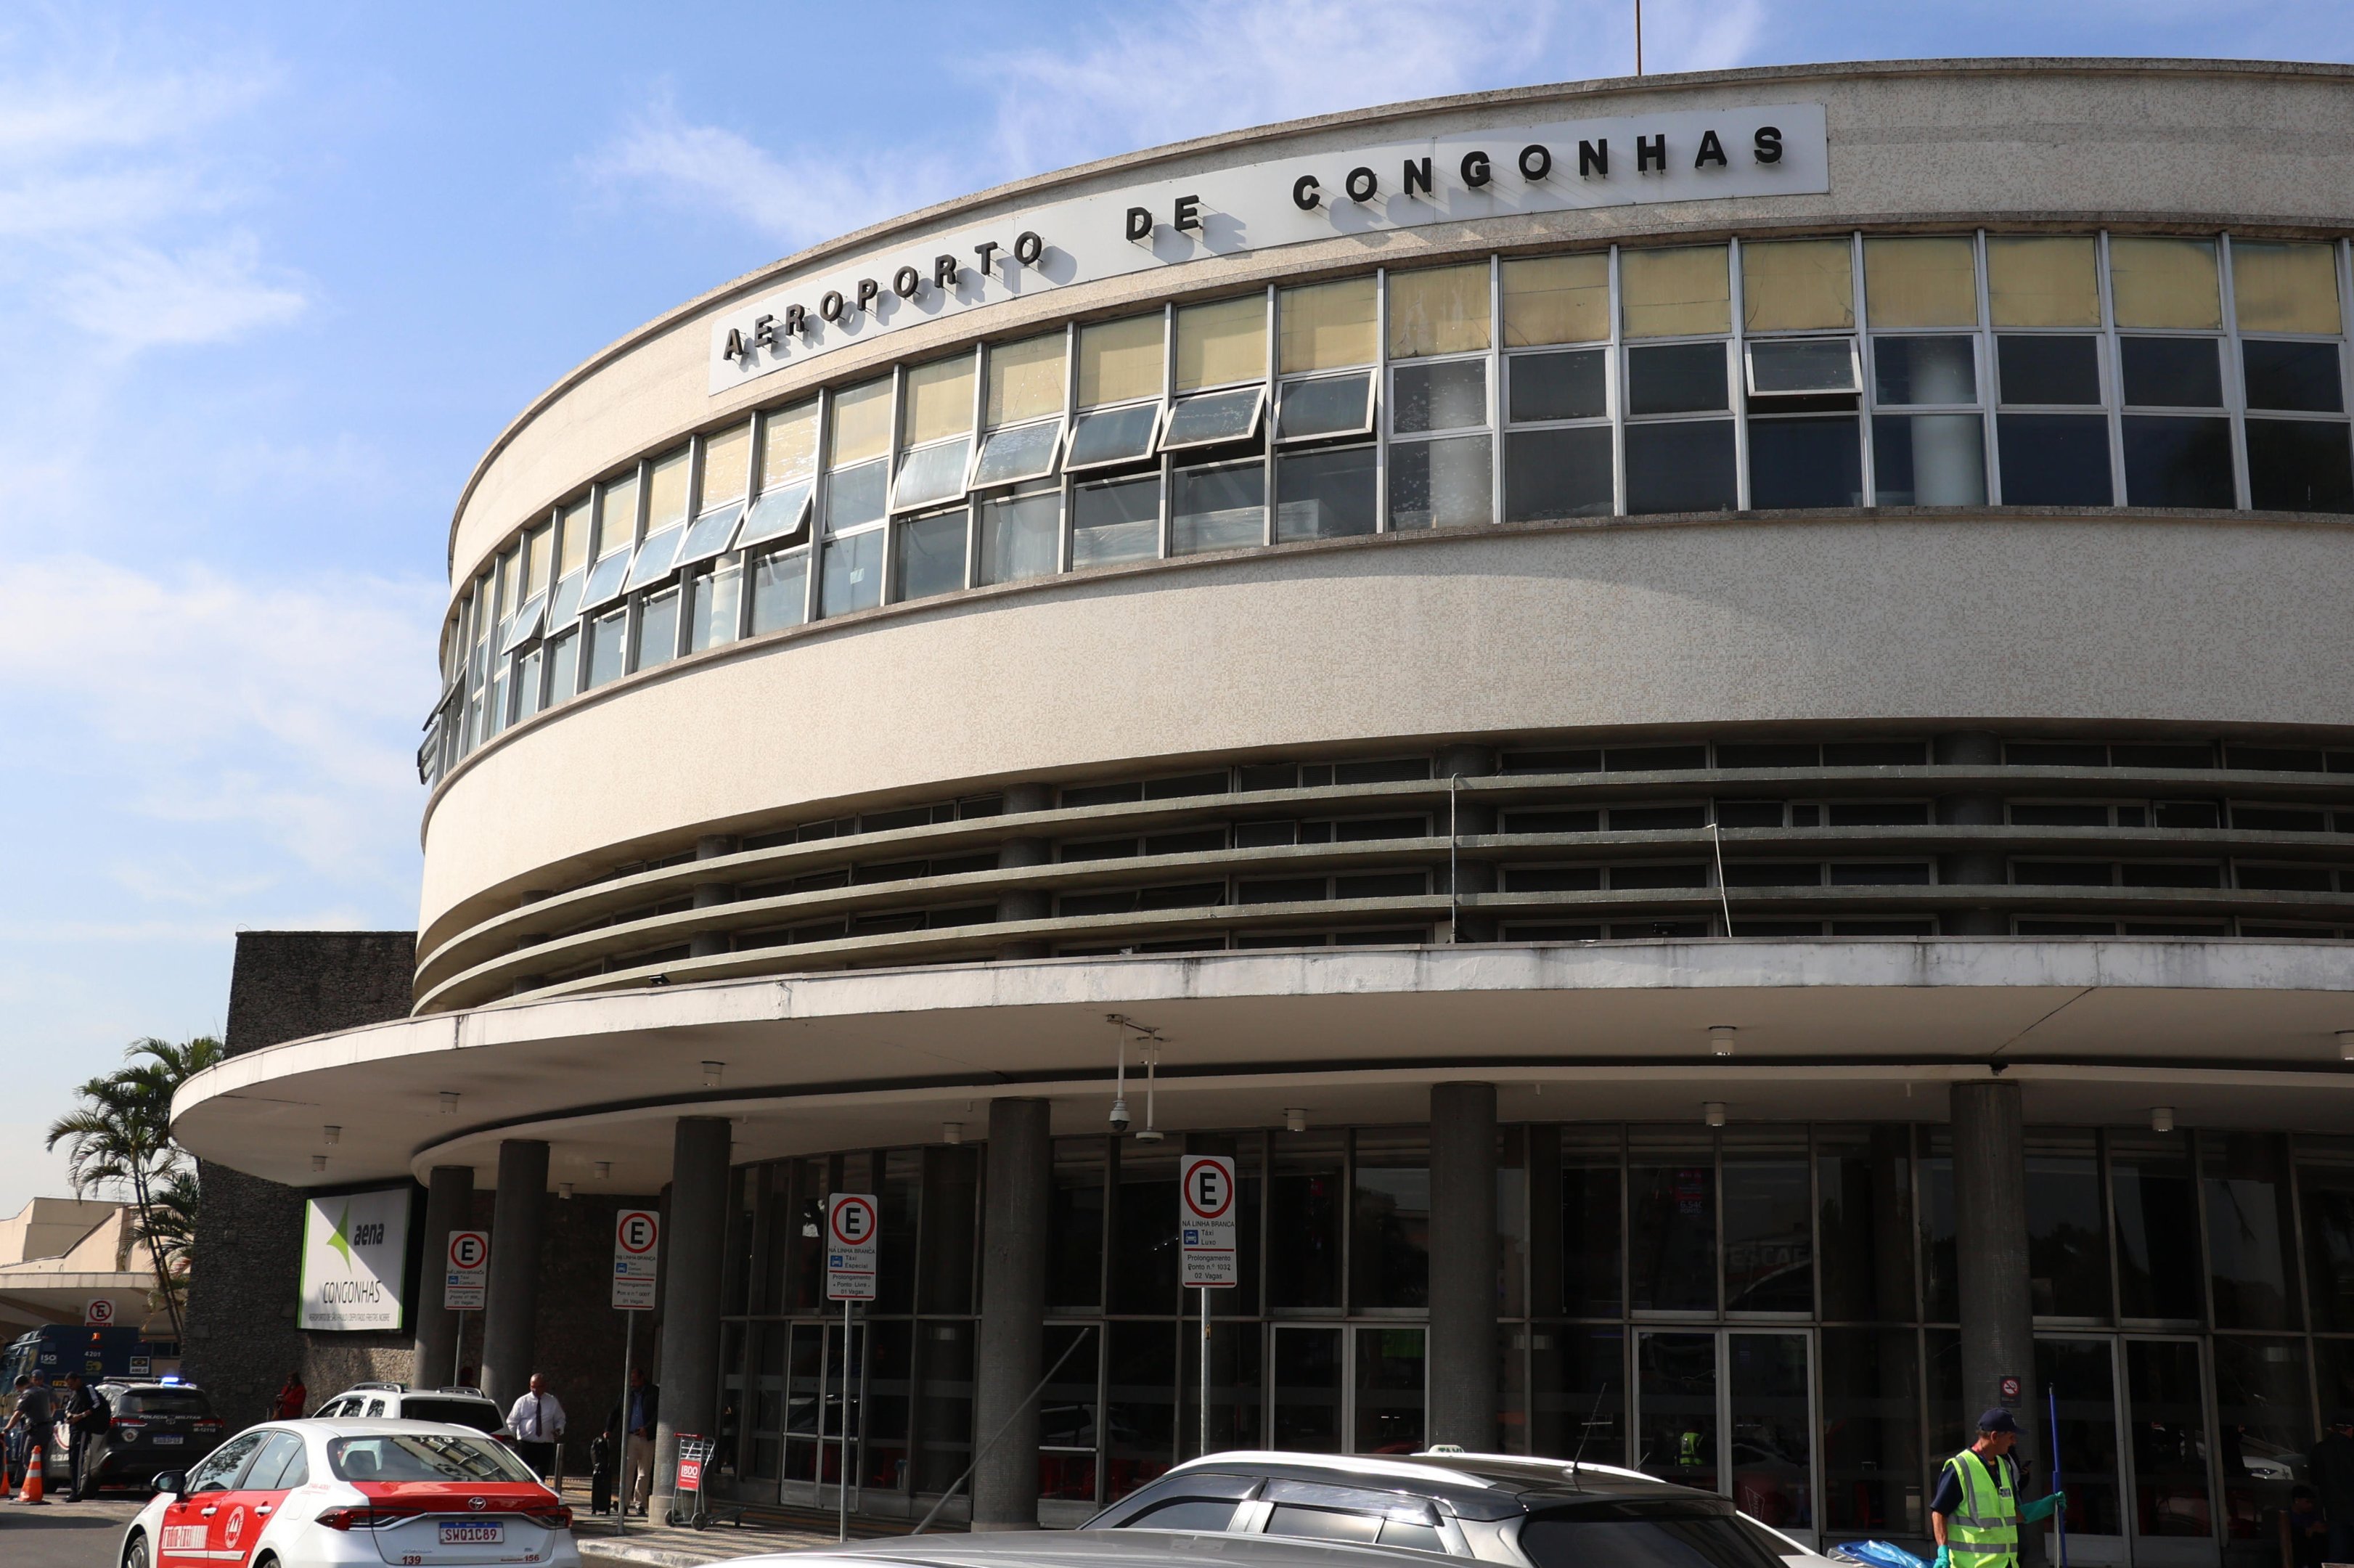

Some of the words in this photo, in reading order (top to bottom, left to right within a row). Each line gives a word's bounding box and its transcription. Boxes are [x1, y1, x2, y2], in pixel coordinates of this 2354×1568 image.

[724, 231, 1042, 361] AEROPORTO
[1126, 195, 1202, 242] DE
[1292, 126, 1783, 211] CONGONHAS
[1199, 1172, 1217, 1205] E
[846, 1207, 861, 1234] E
[353, 1223, 385, 1246] aena
[630, 1222, 645, 1244] E
[461, 1241, 475, 1261] E
[1187, 1254, 1231, 1263] Prolongamento
[322, 1279, 381, 1304] CONGONHAS
[683, 1465, 698, 1476] BDO
[445, 1529, 497, 1541] SWQ1C89
[402, 1555, 422, 1565] 139
